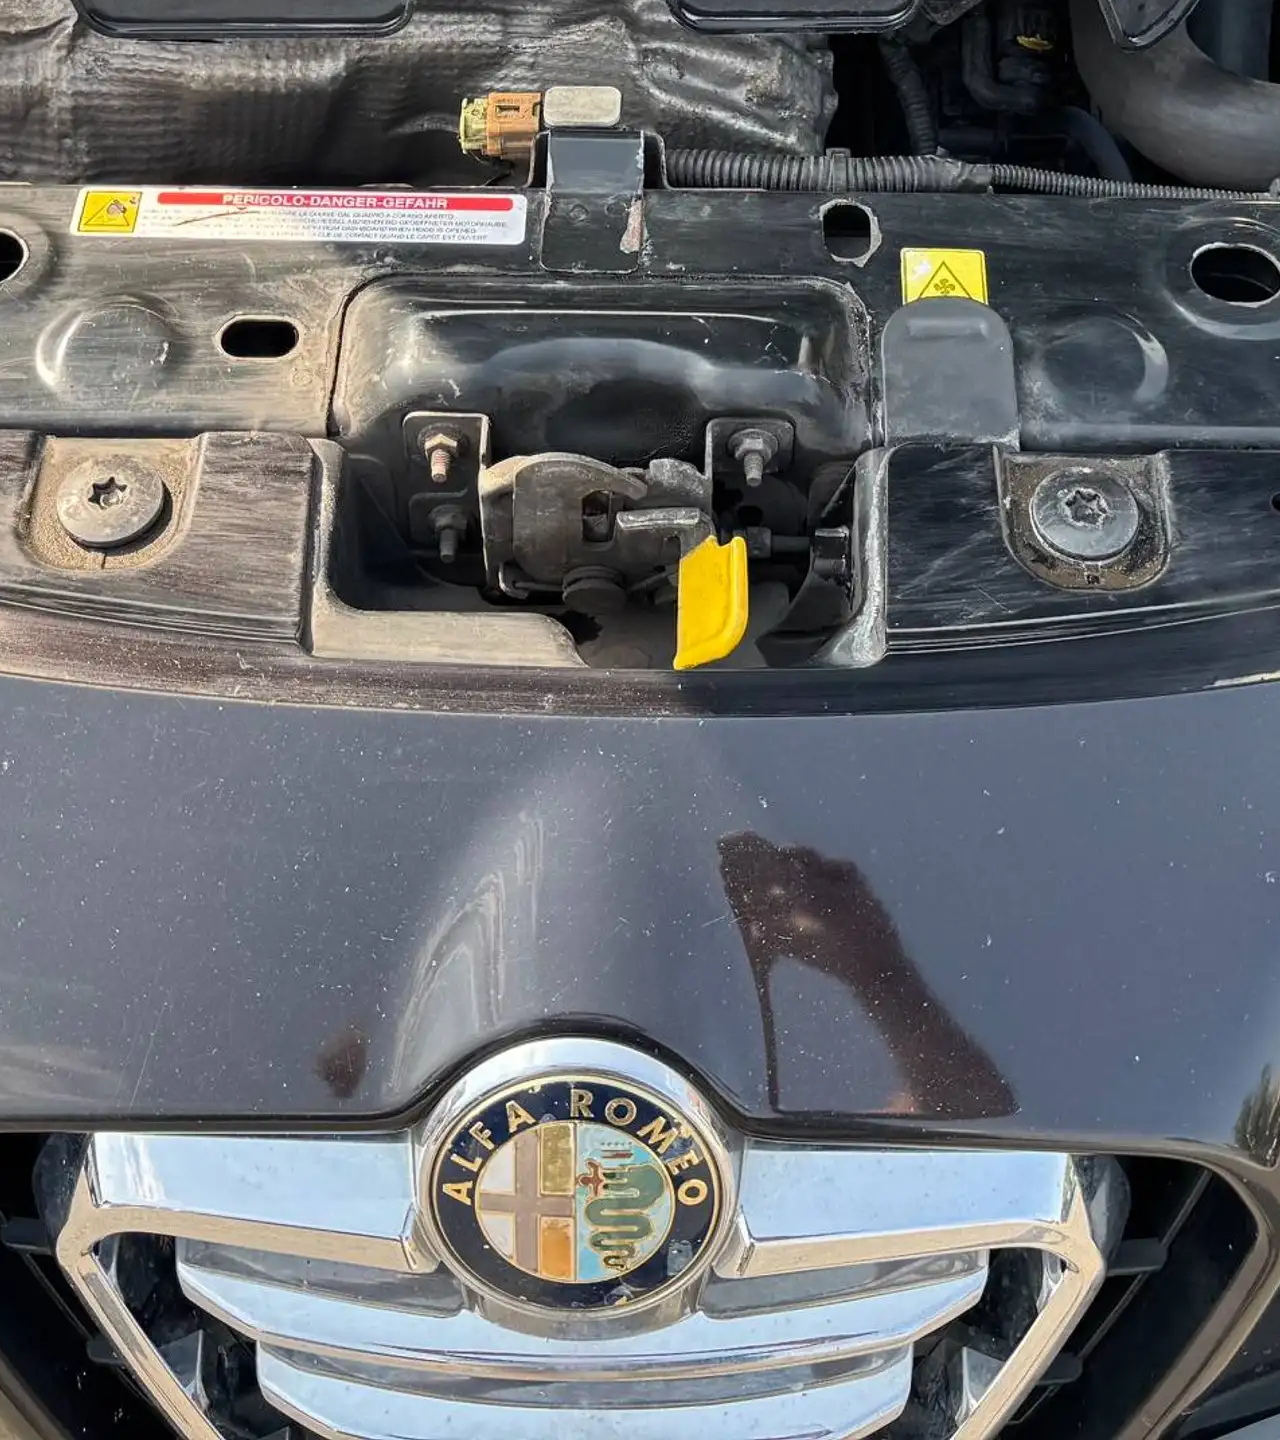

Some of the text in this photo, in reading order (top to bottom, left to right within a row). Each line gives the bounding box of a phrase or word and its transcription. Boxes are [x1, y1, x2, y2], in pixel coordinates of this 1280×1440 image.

[221, 193, 449, 210] PERICOLO-DANGER-GEFAHR
[441, 1088, 709, 1207] ALFA ROMEO
